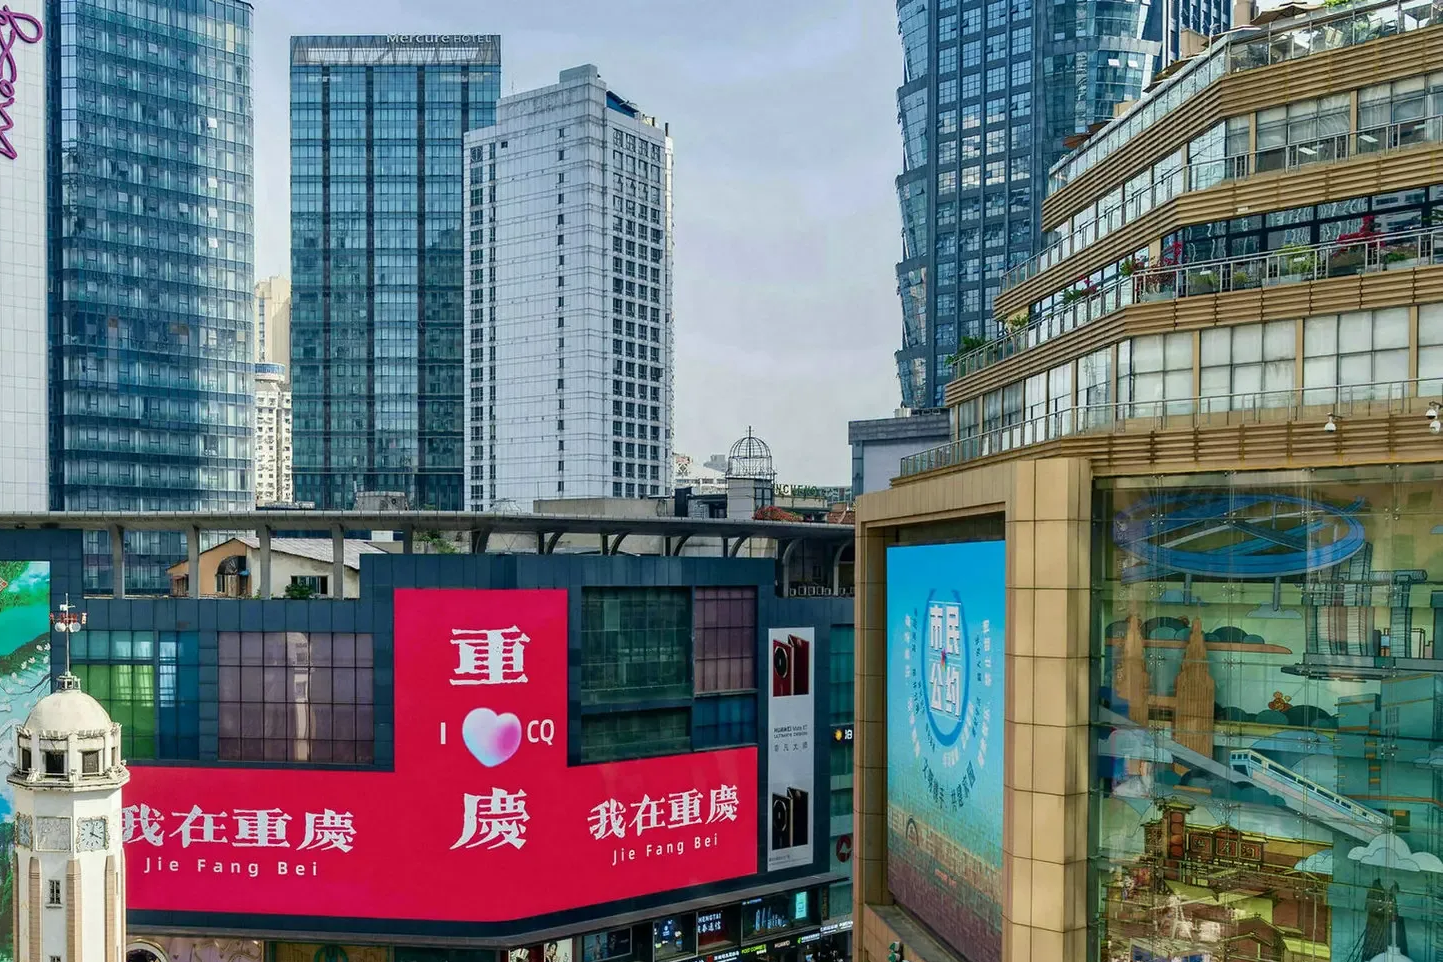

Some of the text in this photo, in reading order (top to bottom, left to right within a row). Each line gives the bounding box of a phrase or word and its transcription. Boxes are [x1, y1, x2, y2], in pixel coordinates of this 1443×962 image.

[386, 32, 493, 43] Mercure HOTEL
[440, 718, 555, 745] I CQ
[587, 784, 740, 840] 我在重慶
[122, 803, 357, 853] 我在重慶
[612, 833, 718, 866] Jie Fang Bei
[144, 857, 318, 877] Jie Fang Bei
